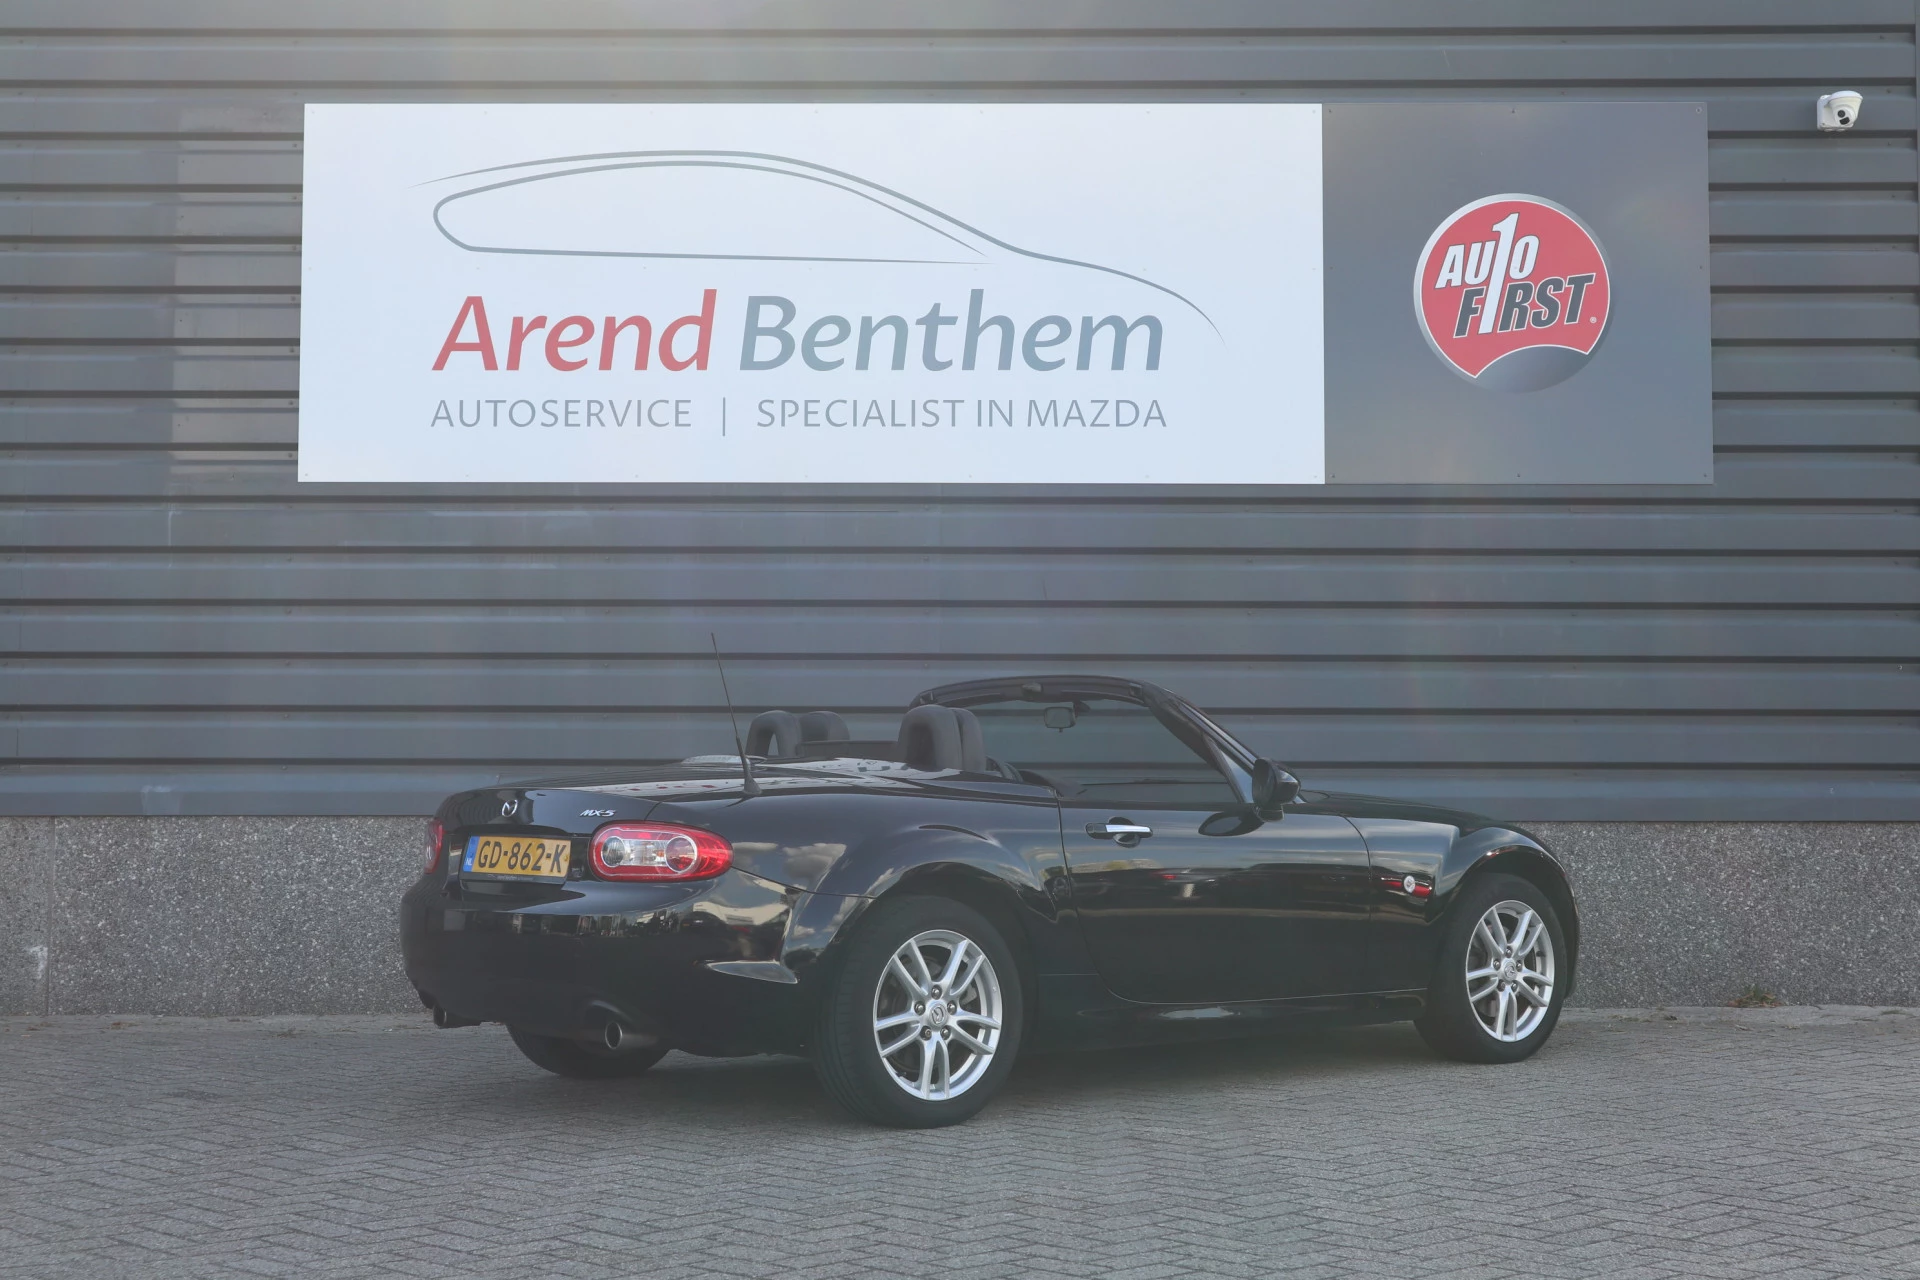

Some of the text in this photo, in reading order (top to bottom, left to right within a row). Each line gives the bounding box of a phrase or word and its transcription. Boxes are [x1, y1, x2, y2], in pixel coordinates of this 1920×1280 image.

[431, 288, 1164, 372] Arend Benthem
[430, 399, 1167, 428] AUTOSERVICE SPECIALIST IN MAZDA
[478, 840, 567, 874] GD-862-K
